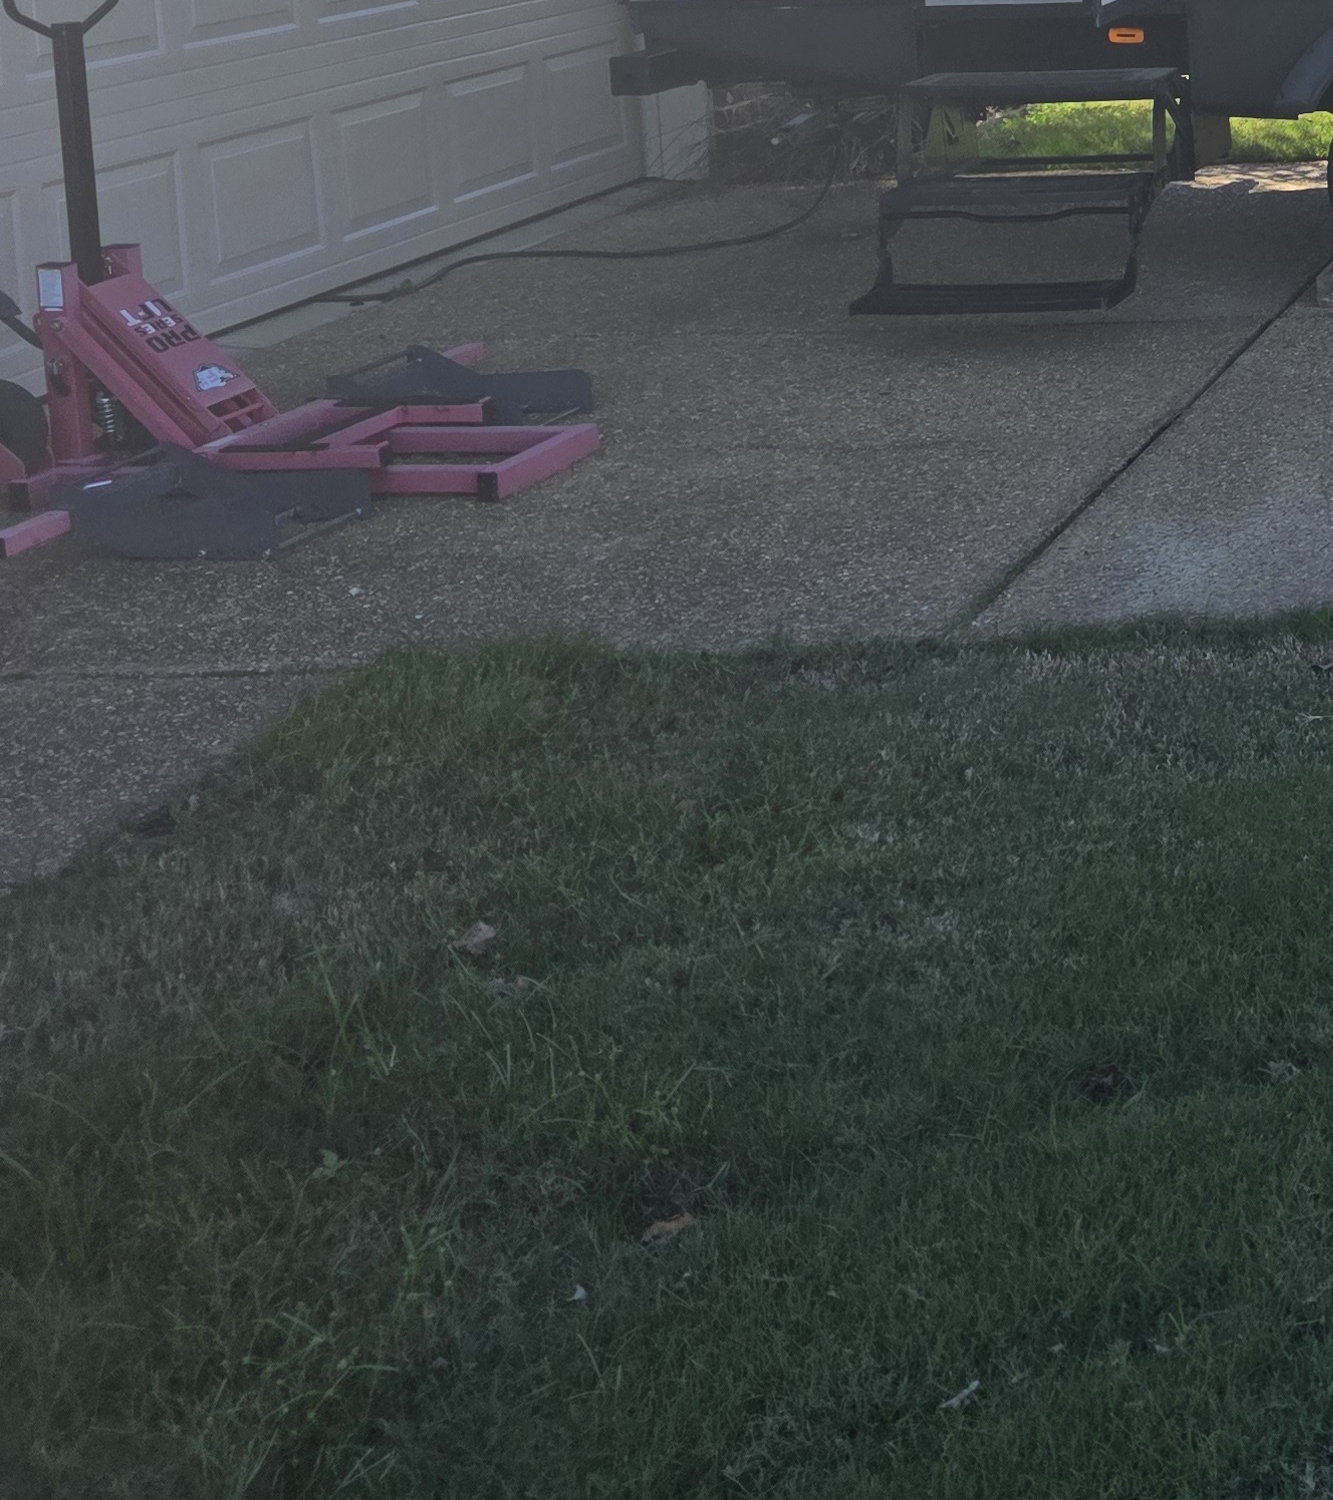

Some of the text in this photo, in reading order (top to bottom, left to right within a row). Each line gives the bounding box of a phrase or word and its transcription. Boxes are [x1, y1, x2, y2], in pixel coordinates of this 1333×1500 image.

[119, 298, 173, 327] LIFT
[134, 314, 183, 337] SERIES
[145, 324, 201, 353] PRO
